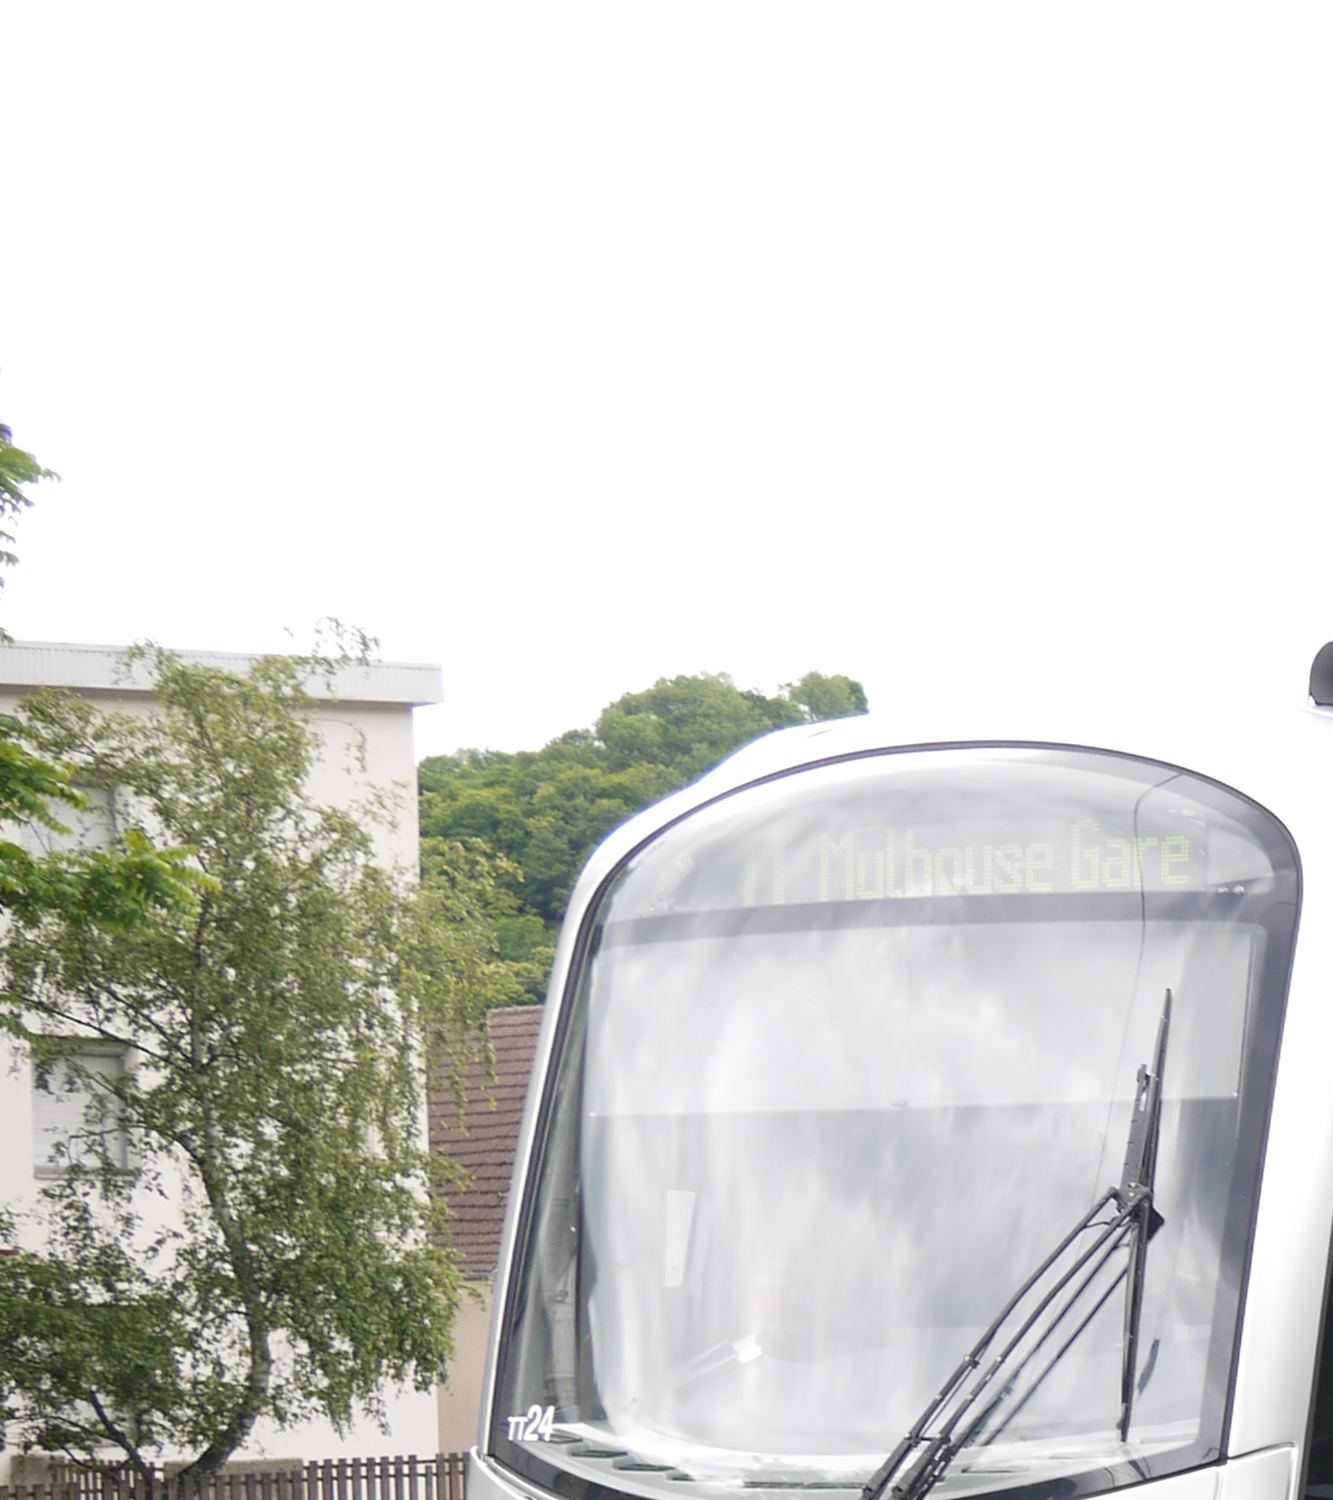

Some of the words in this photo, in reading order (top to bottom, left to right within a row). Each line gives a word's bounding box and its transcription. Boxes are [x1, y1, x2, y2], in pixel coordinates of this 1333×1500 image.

[818, 828, 1054, 901] Mulhouse
[1071, 818, 1190, 890] Gare
[507, 1404, 556, 1442] TT24
